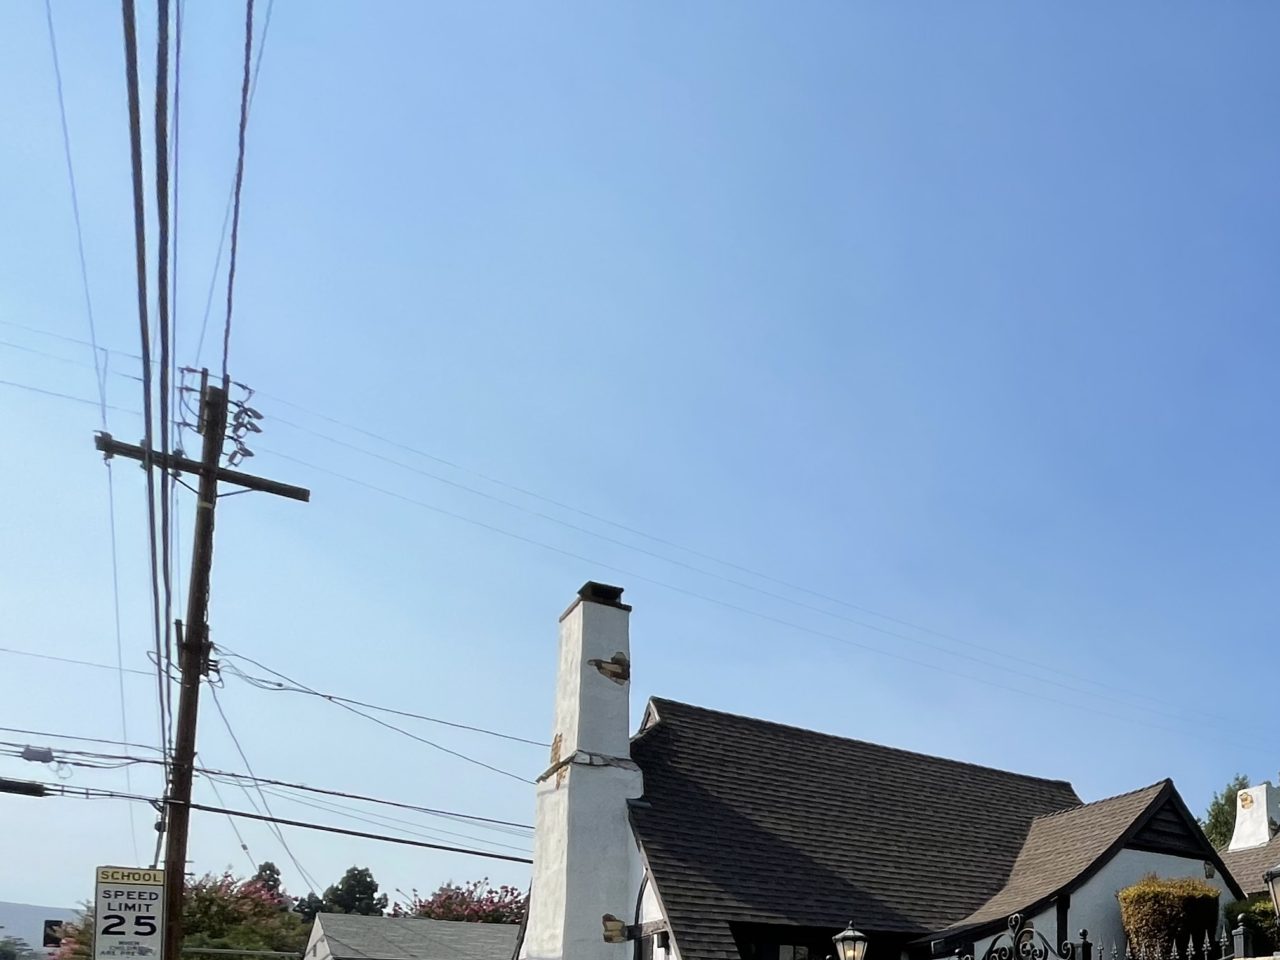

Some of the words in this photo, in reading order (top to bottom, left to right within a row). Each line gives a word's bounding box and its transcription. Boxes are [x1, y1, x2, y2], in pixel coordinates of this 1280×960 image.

[101, 871, 161, 882] SCHOOL
[102, 890, 159, 900] SPEED
[107, 902, 153, 912] LIMIT
[101, 914, 157, 936] 25
